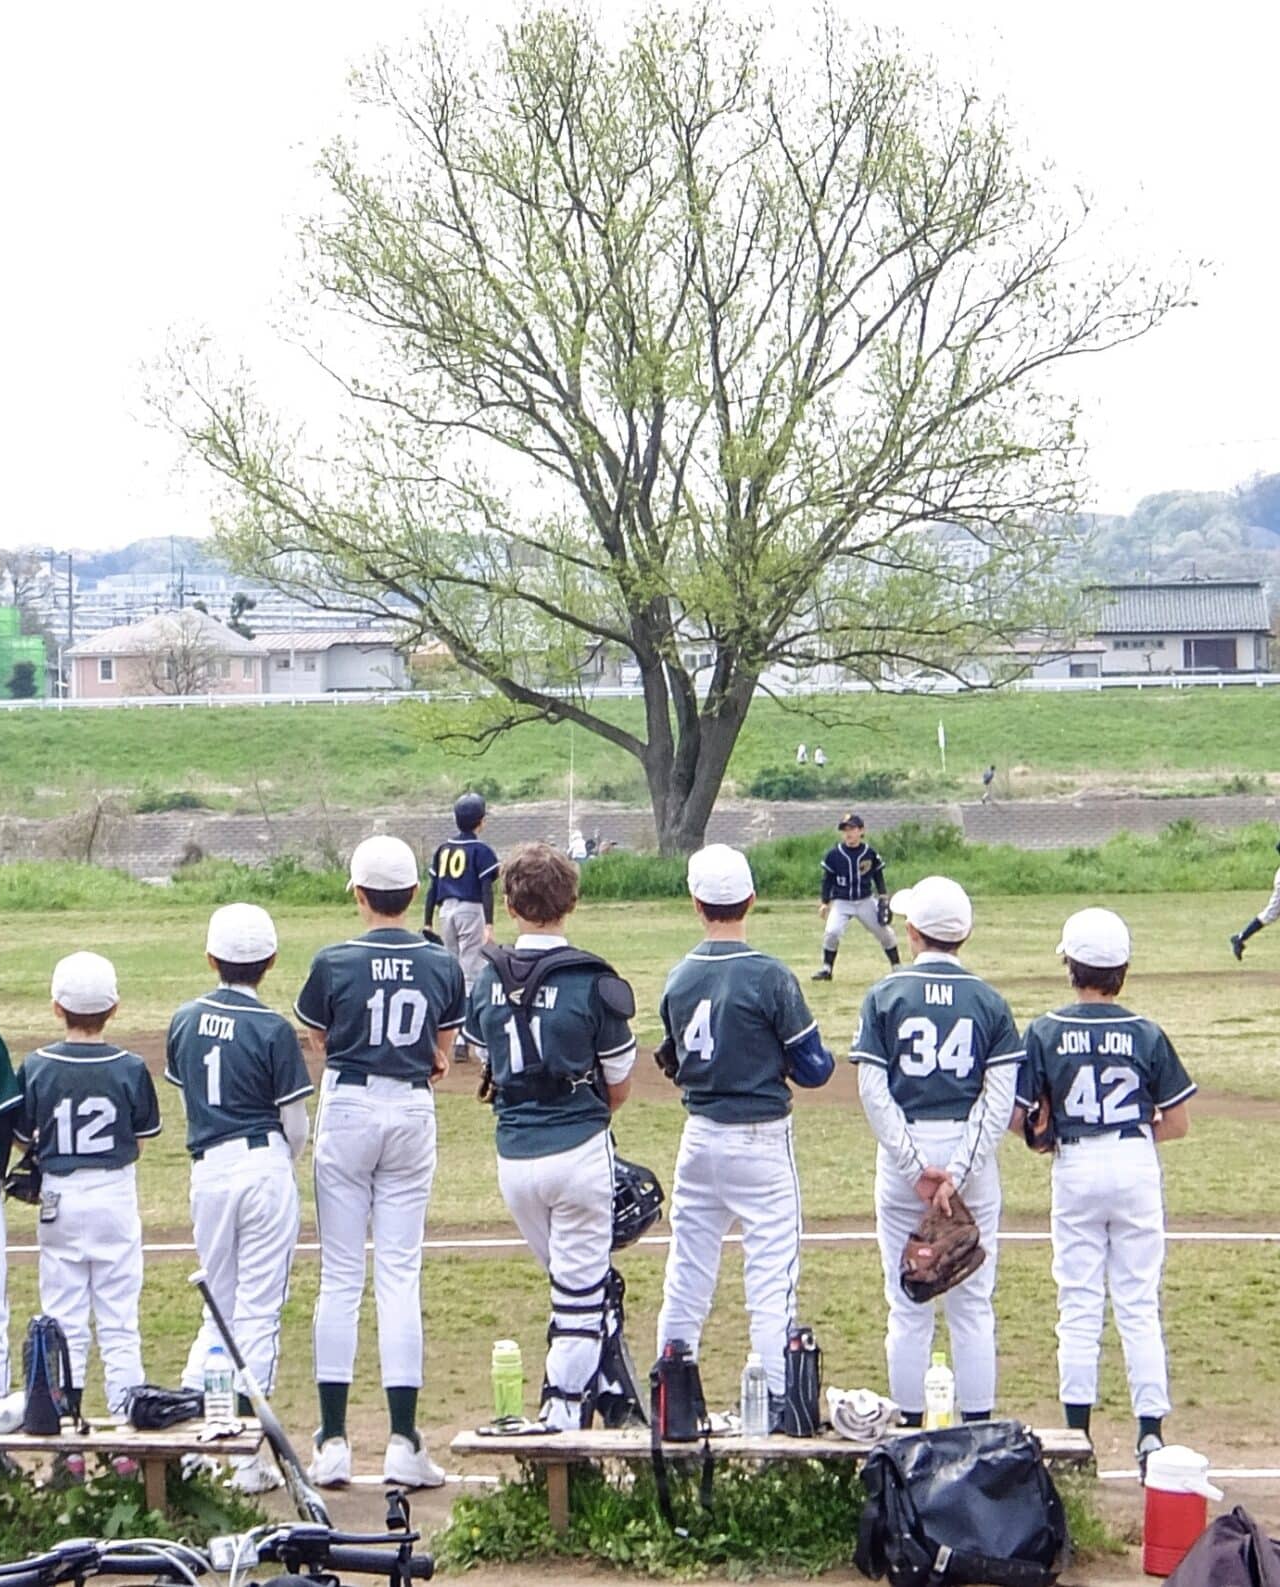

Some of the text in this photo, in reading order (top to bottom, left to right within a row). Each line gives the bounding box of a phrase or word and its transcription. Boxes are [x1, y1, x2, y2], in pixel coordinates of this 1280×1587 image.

[438, 848, 466, 878] 10
[372, 959, 413, 982] RAFE
[925, 983, 952, 1006] IAN
[198, 1013, 236, 1040] KOTA
[367, 988, 428, 1048] 10
[684, 999, 714, 1061] 4
[1056, 1030, 1133, 1056] JON JON
[203, 1045, 222, 1106] 1
[898, 1017, 974, 1079] 34
[1064, 1065, 1141, 1124] 42
[52, 1097, 118, 1155] 12
